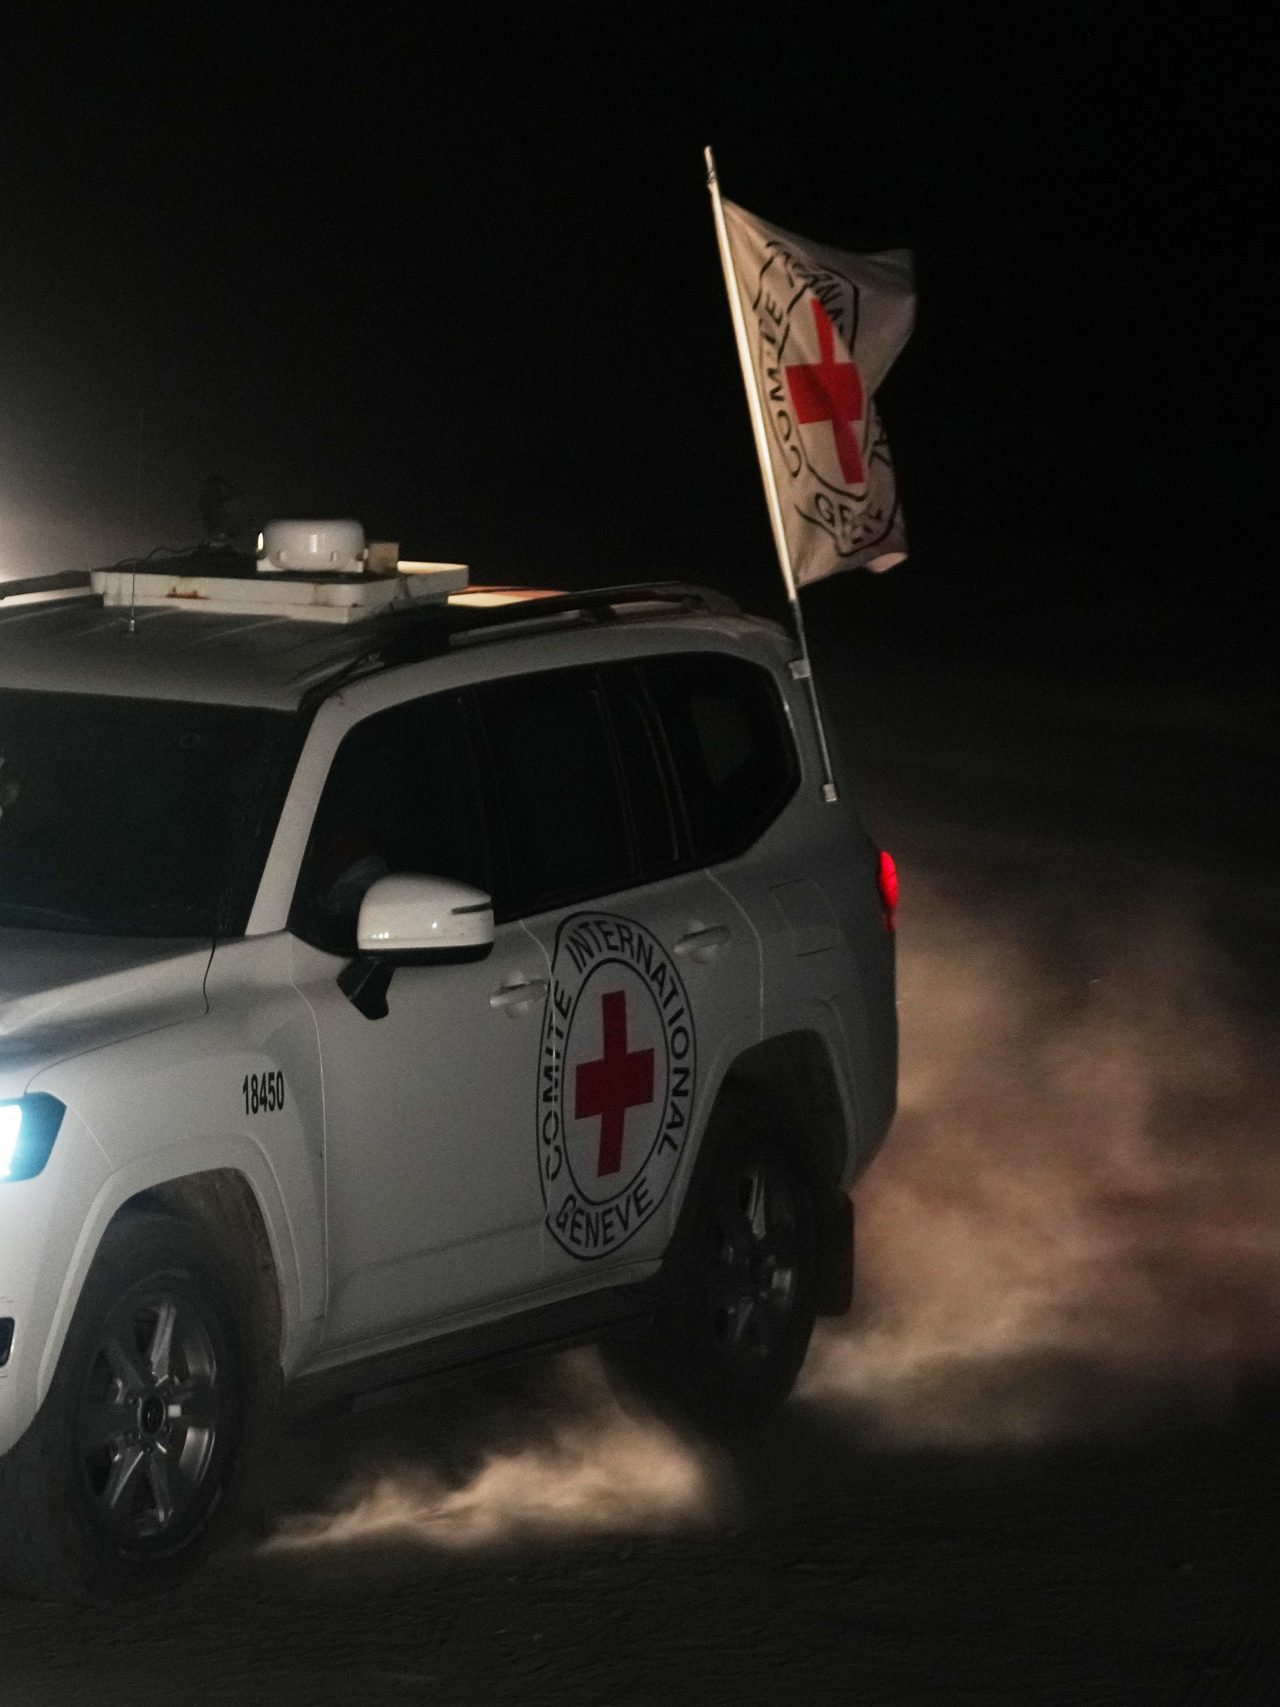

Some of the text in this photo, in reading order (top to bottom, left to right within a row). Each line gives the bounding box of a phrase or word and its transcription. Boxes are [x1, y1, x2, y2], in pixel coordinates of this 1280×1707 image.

[242, 1070, 284, 1115] 18450
[543, 920, 690, 1248] COMITE INTERNATIONAL GENEVE
